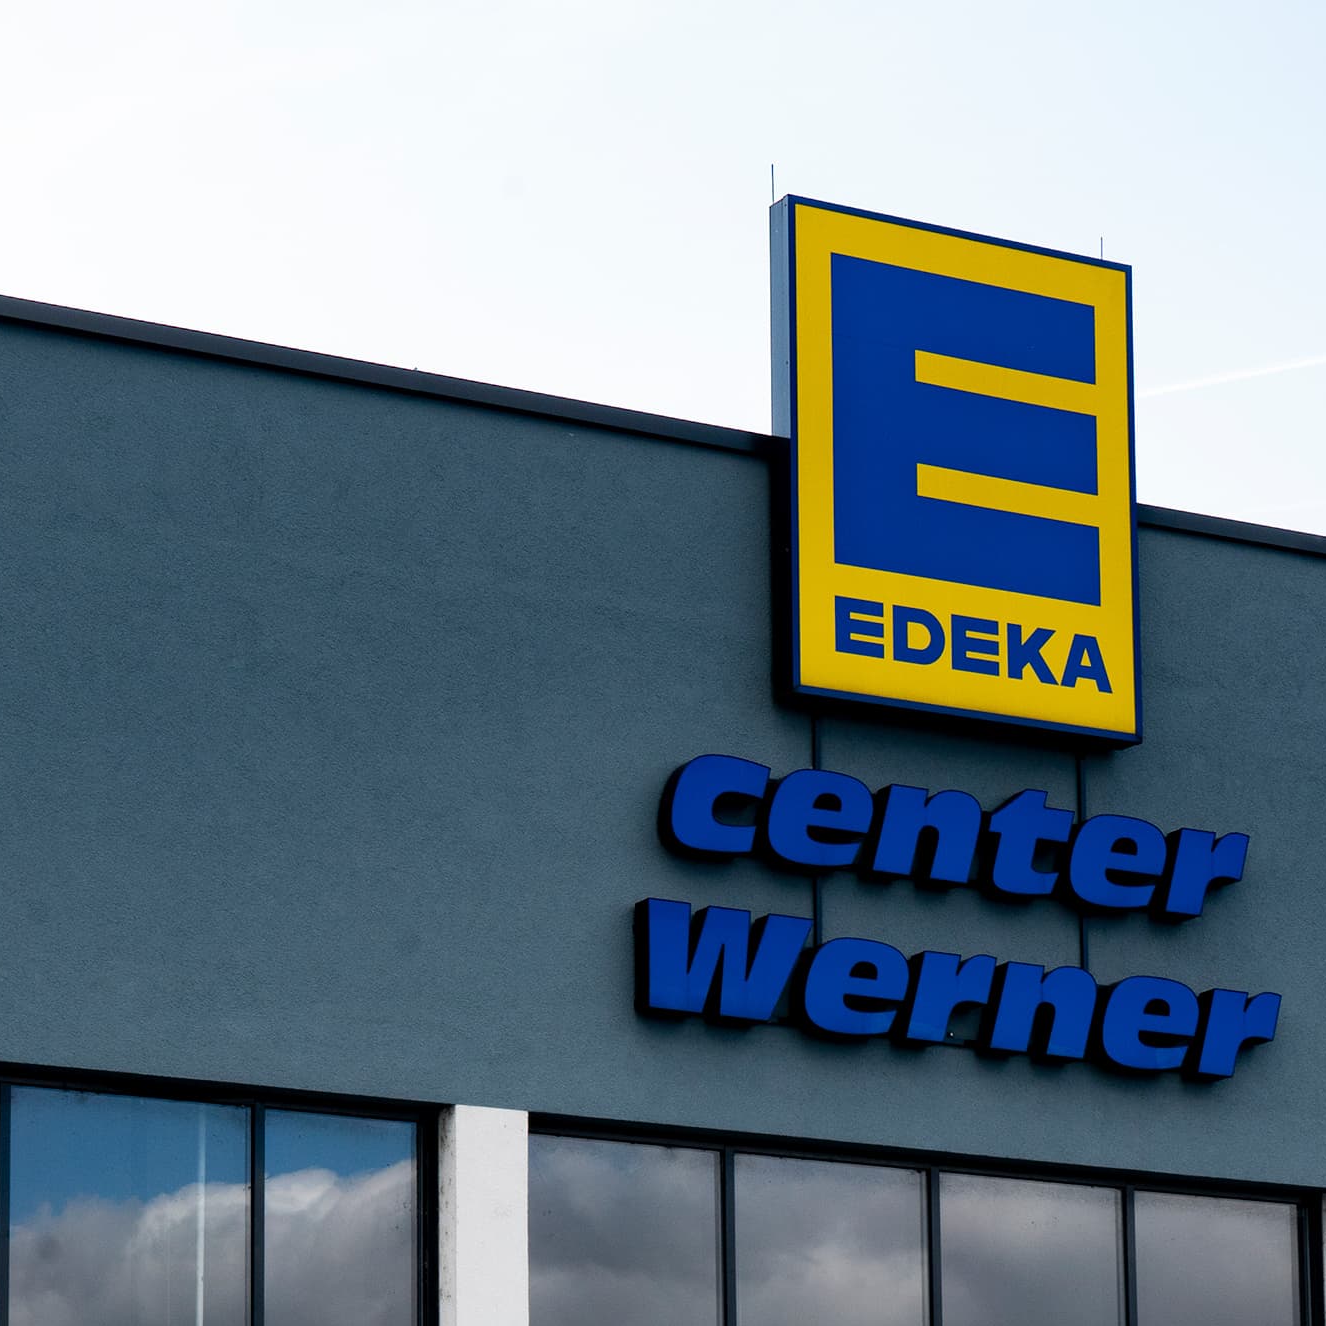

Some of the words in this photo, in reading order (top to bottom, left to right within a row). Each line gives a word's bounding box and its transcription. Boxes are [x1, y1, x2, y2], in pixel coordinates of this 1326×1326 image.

[834, 595, 1113, 695] EDEKA
[665, 752, 1251, 921] center
[637, 896, 1283, 1081] Werner
